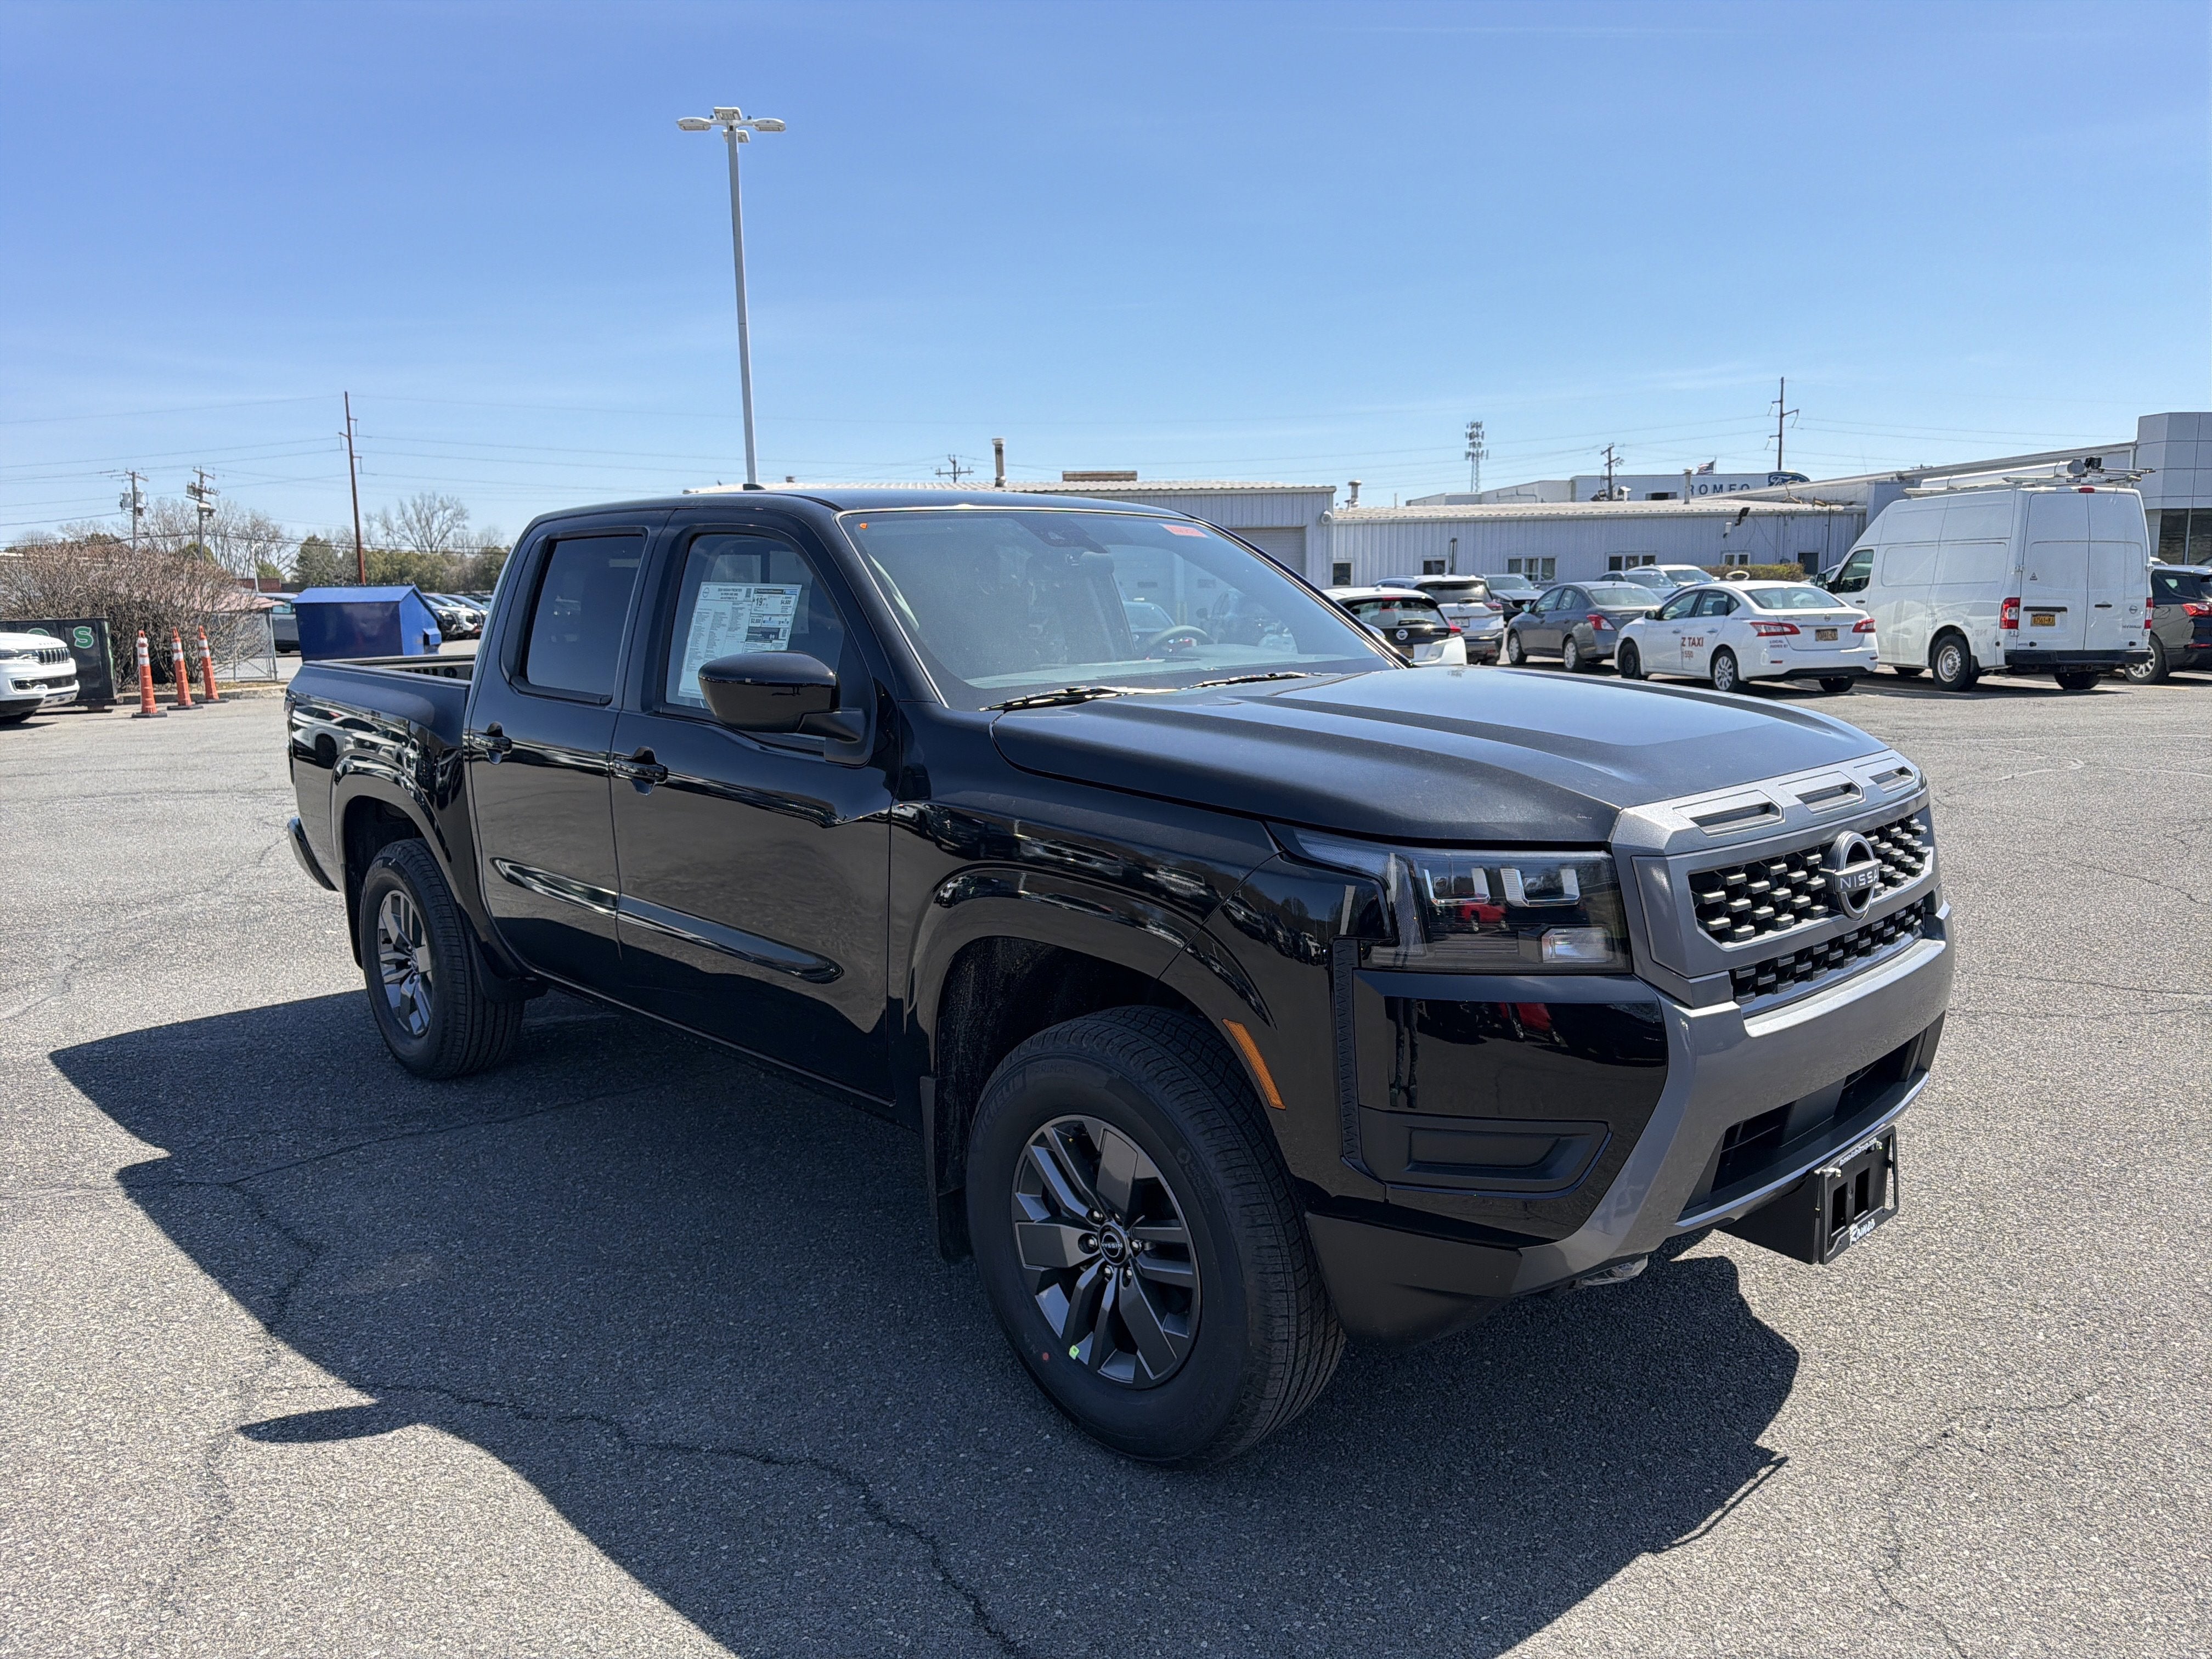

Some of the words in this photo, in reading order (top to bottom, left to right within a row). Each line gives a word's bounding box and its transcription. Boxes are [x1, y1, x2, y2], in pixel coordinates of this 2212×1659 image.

[1690, 483, 1750, 496] ROMEO
[756, 597, 763, 607] 19
[1681, 637, 1686, 647] Z
[1688, 636, 1704, 647] TAXI
[1840, 869, 1878, 889] NISSA
[1849, 1218, 1876, 1246] Romeo
